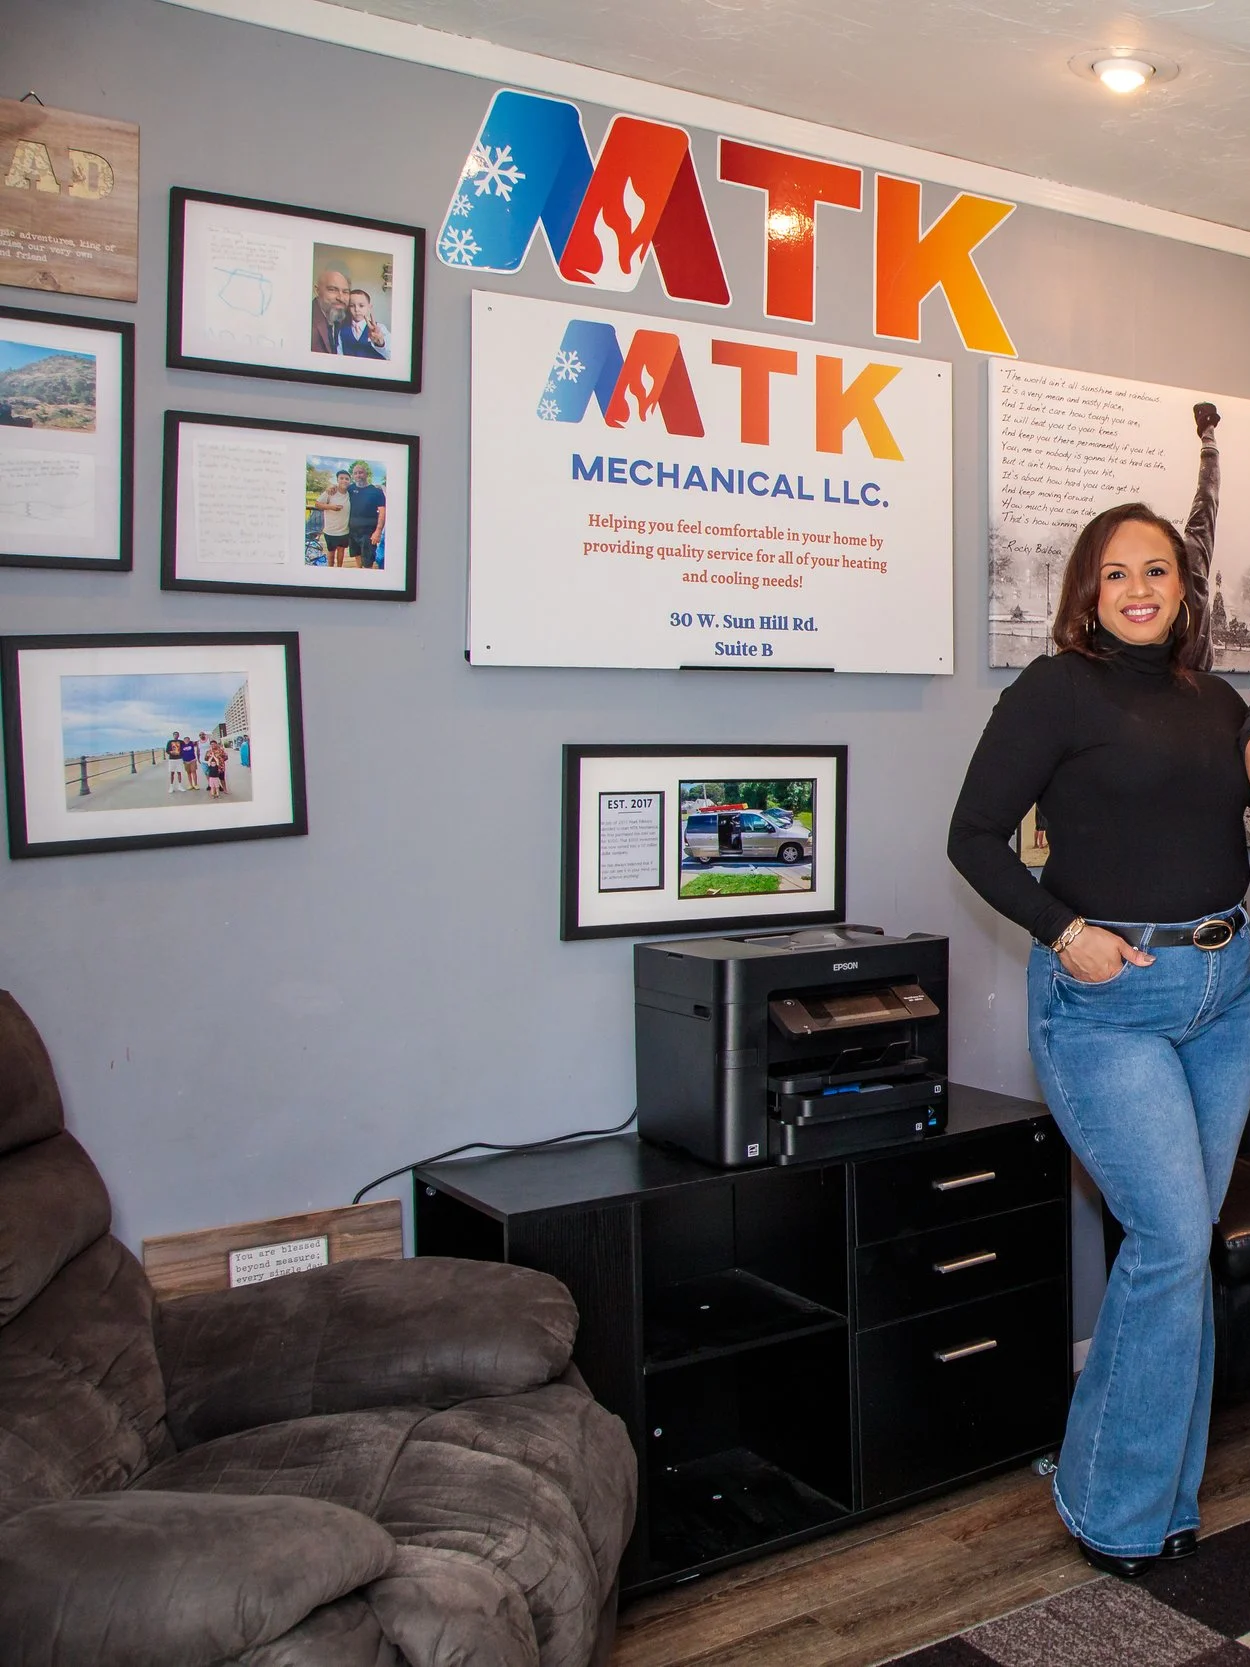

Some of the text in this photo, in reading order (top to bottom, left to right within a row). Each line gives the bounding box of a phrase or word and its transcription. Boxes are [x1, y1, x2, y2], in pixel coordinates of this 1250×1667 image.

[4, 139, 114, 199] AD
[437, 88, 1018, 358] MTK
[28, 244, 93, 258] our very own
[80, 240, 100, 251] king
[16, 250, 48, 262] friend
[536, 319, 904, 462] MTK
[1024, 376, 1046, 384] world
[1049, 378, 1066, 388] ain't
[1080, 385, 1112, 396] sunshine
[1002, 384, 1018, 394] It's
[1028, 391, 1043, 400] very
[1082, 400, 1101, 409] nasty
[1002, 399, 1016, 408] And
[1026, 403, 1046, 414] don't
[1069, 410, 1086, 418] how
[1088, 413, 1110, 424] tough
[1002, 414, 1012, 422] It
[1030, 418, 1046, 427] beat
[1002, 427, 1016, 436] And
[1018, 429, 1034, 441] keep
[1036, 435, 1050, 443] you
[1054, 436, 1074, 444] there
[1076, 440, 1120, 452] permanently
[1146, 447, 1156, 455] let
[1002, 441, 1020, 453] You,
[1046, 449, 1072, 460] nobody
[1083, 456, 1106, 464] gonna
[1108, 456, 1118, 464] hit
[1028, 458, 1044, 468] ain't
[1046, 462, 1062, 471] how
[1065, 465, 1082, 474] hard
[572, 453, 890, 508] MECHANICAL LLC.
[1002, 469, 1018, 480] It's
[1021, 472, 1044, 482] about
[1046, 476, 1062, 485] how
[1064, 478, 1082, 487] hard
[1083, 482, 1098, 490] you
[1115, 485, 1128, 494] get
[1130, 486, 1140, 494] hit
[1002, 484, 1016, 494] And
[1018, 486, 1035, 498] keep
[1038, 492, 1061, 502] moving
[1002, 497, 1022, 509] How
[1081, 507, 1096, 517] take
[1002, 511, 1078, 532] That's how winning
[588, 514, 884, 551] Helping you feel comfortable in your home by
[583, 540, 888, 574] providing quality service for all of your heating
[1036, 544, 1062, 555] Balboa
[682, 570, 804, 590] and cooling needs!
[670, 612, 818, 632] 30 W. Sun Hill Rd.
[714, 640, 774, 656] Suite B
[608, 799, 653, 810] EST. 2017
[833, 961, 858, 971] EPSON
[235, 1254, 252, 1262] You
[281, 1240, 321, 1253] blessed
[236, 1260, 271, 1272] beyond
[236, 1272, 264, 1284] every
[270, 1266, 301, 1278] single
